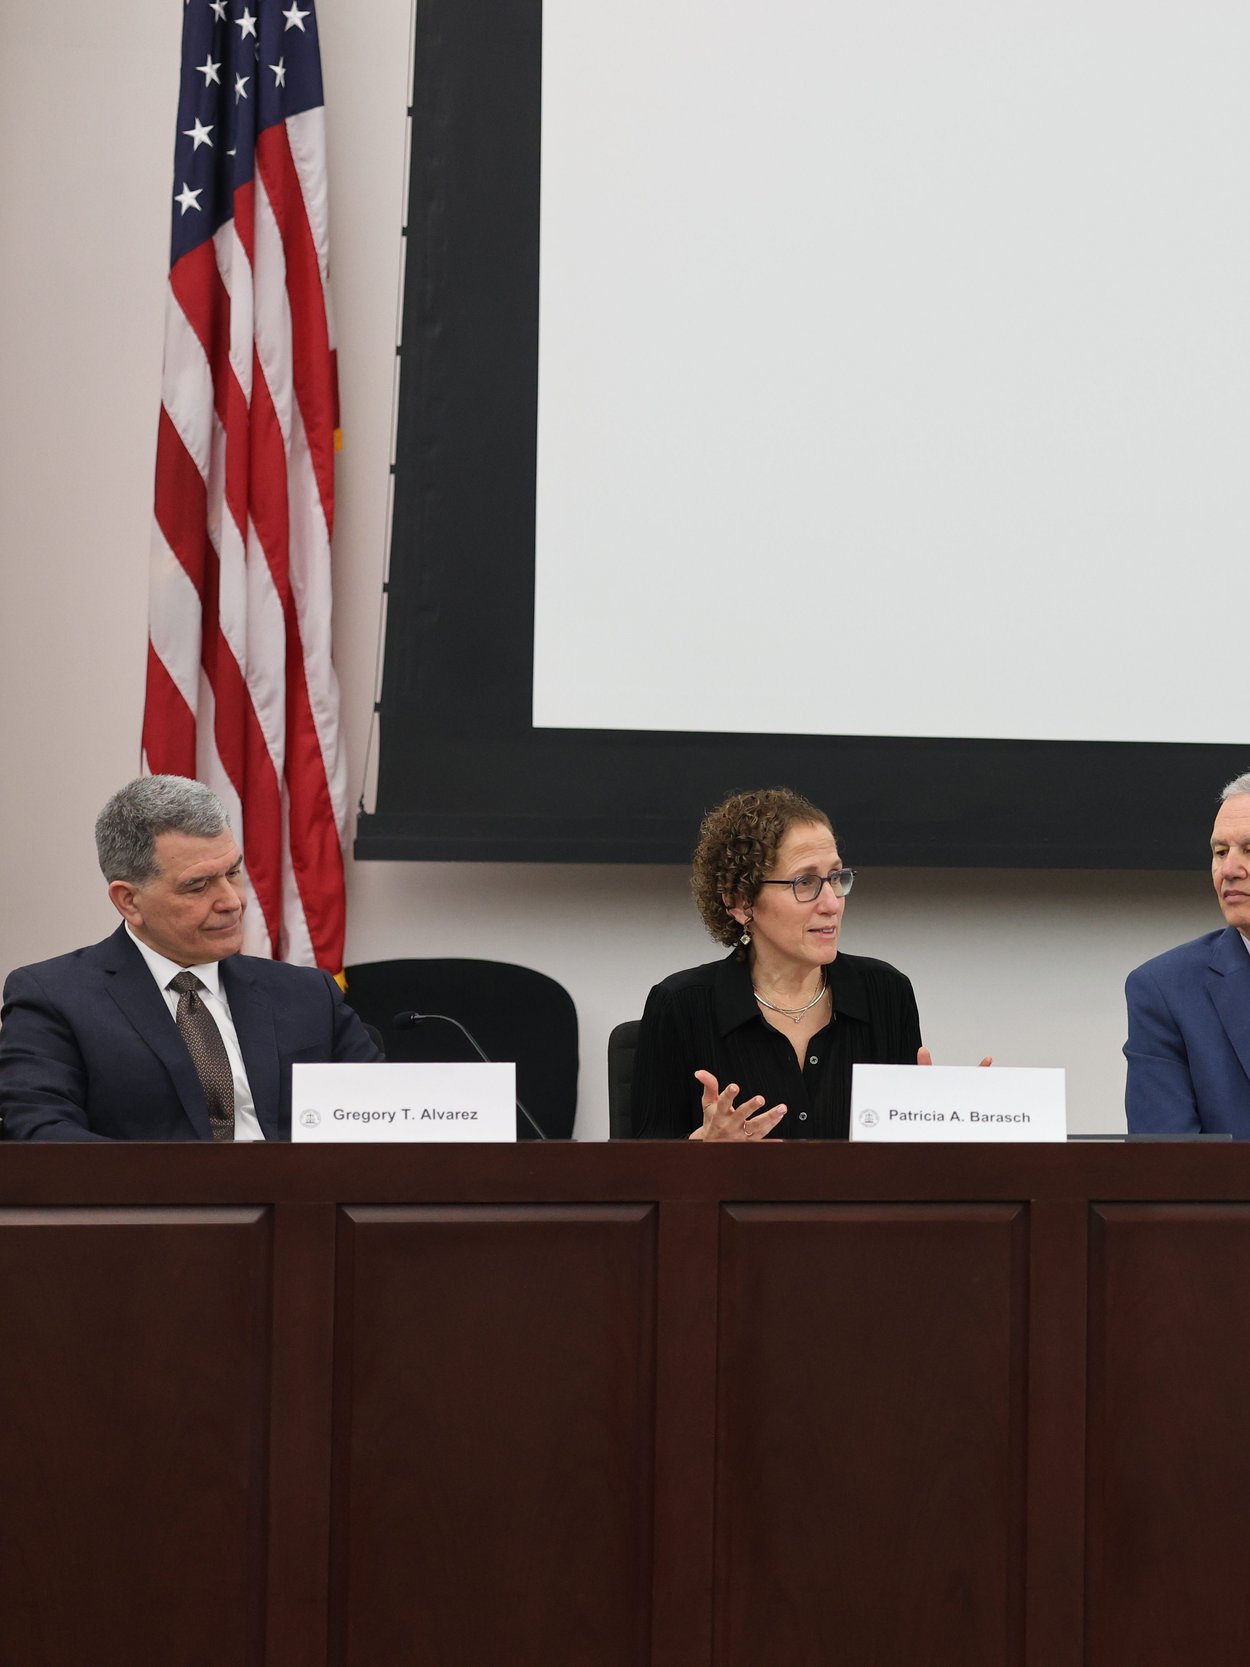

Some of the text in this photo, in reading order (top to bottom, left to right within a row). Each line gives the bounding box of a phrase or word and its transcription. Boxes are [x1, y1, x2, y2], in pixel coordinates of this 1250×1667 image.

[332, 1108, 397, 1124] Gregory
[401, 1108, 415, 1121] T.
[420, 1108, 479, 1121] Alvarez
[889, 1109, 945, 1122] Patricia
[949, 1110, 965, 1122] A.
[969, 1111, 1031, 1123] Barasch
